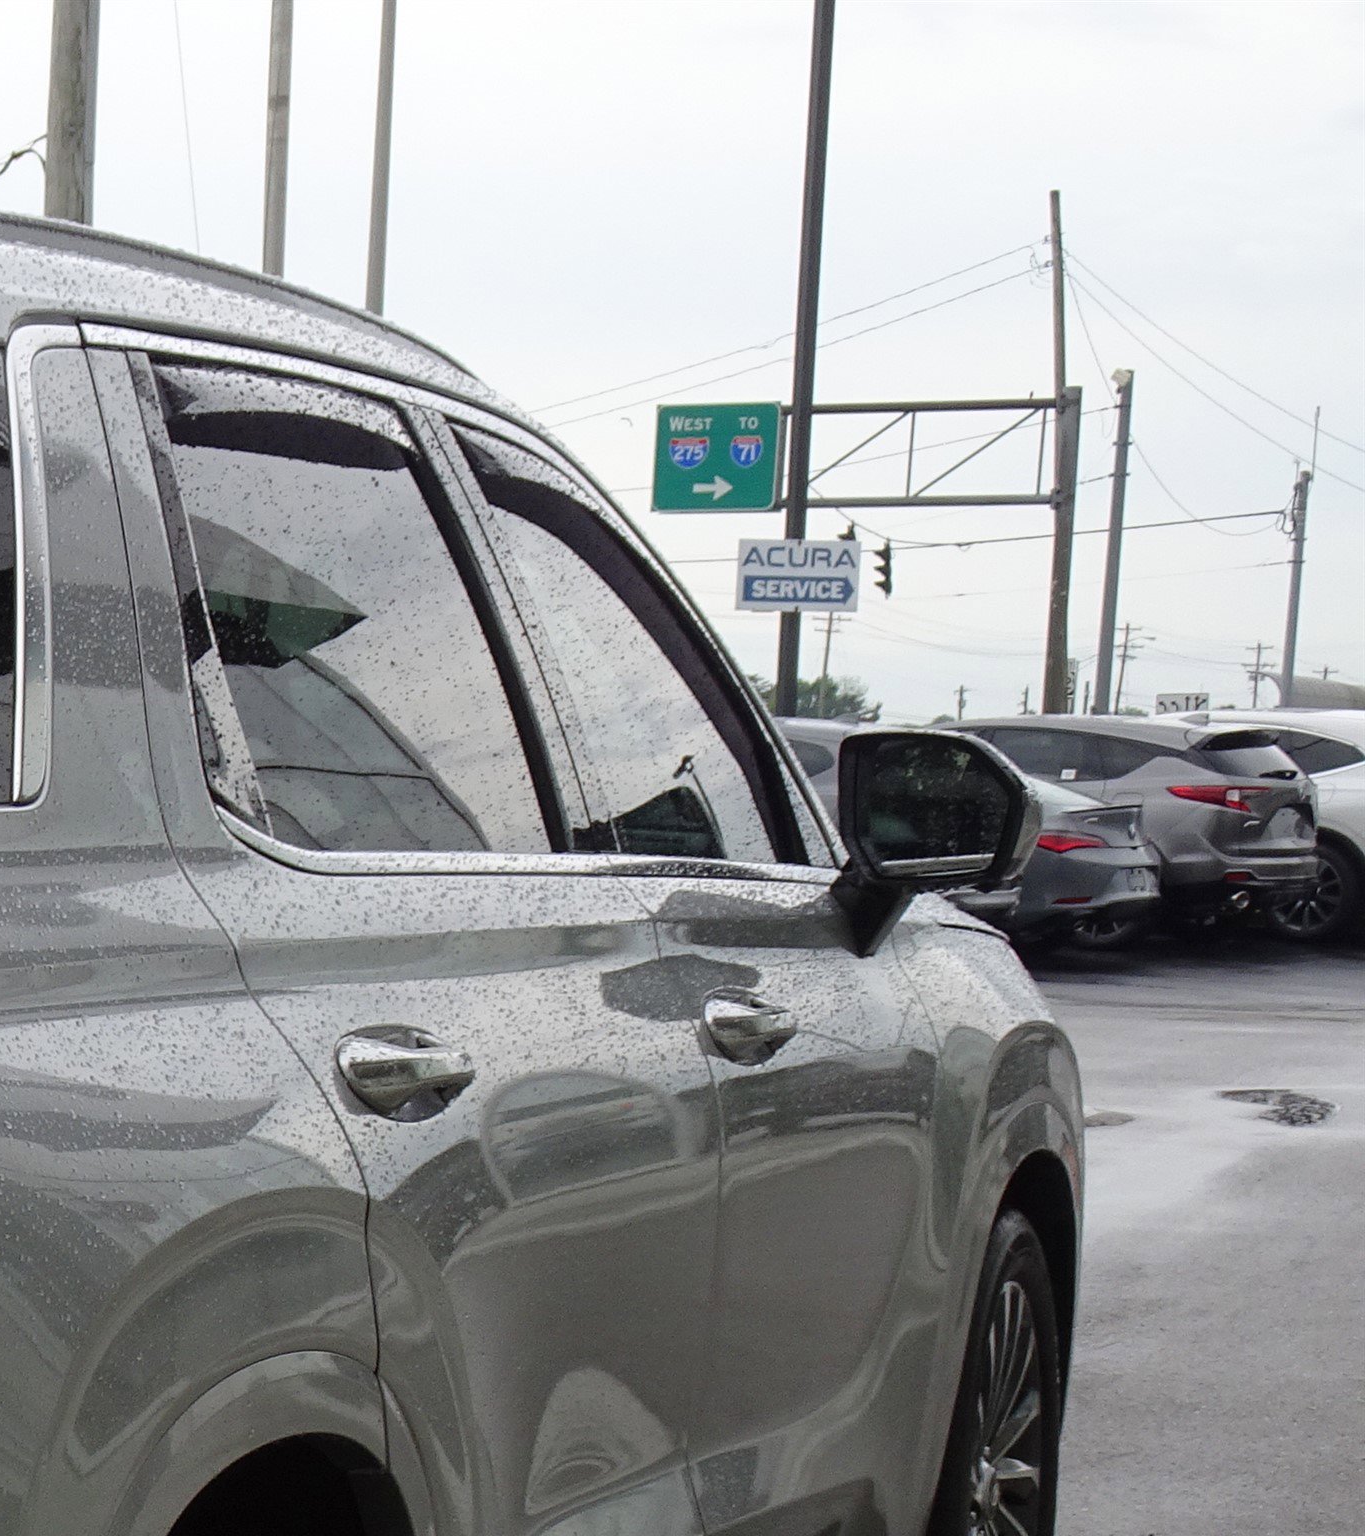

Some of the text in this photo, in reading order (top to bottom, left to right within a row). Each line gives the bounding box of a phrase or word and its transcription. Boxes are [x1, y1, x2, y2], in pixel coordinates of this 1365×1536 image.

[669, 416, 759, 432] WEST TO
[673, 445, 705, 462] 275
[738, 445, 757, 461] 71
[741, 545, 857, 569] ACURA
[750, 579, 845, 599] SERVICE
